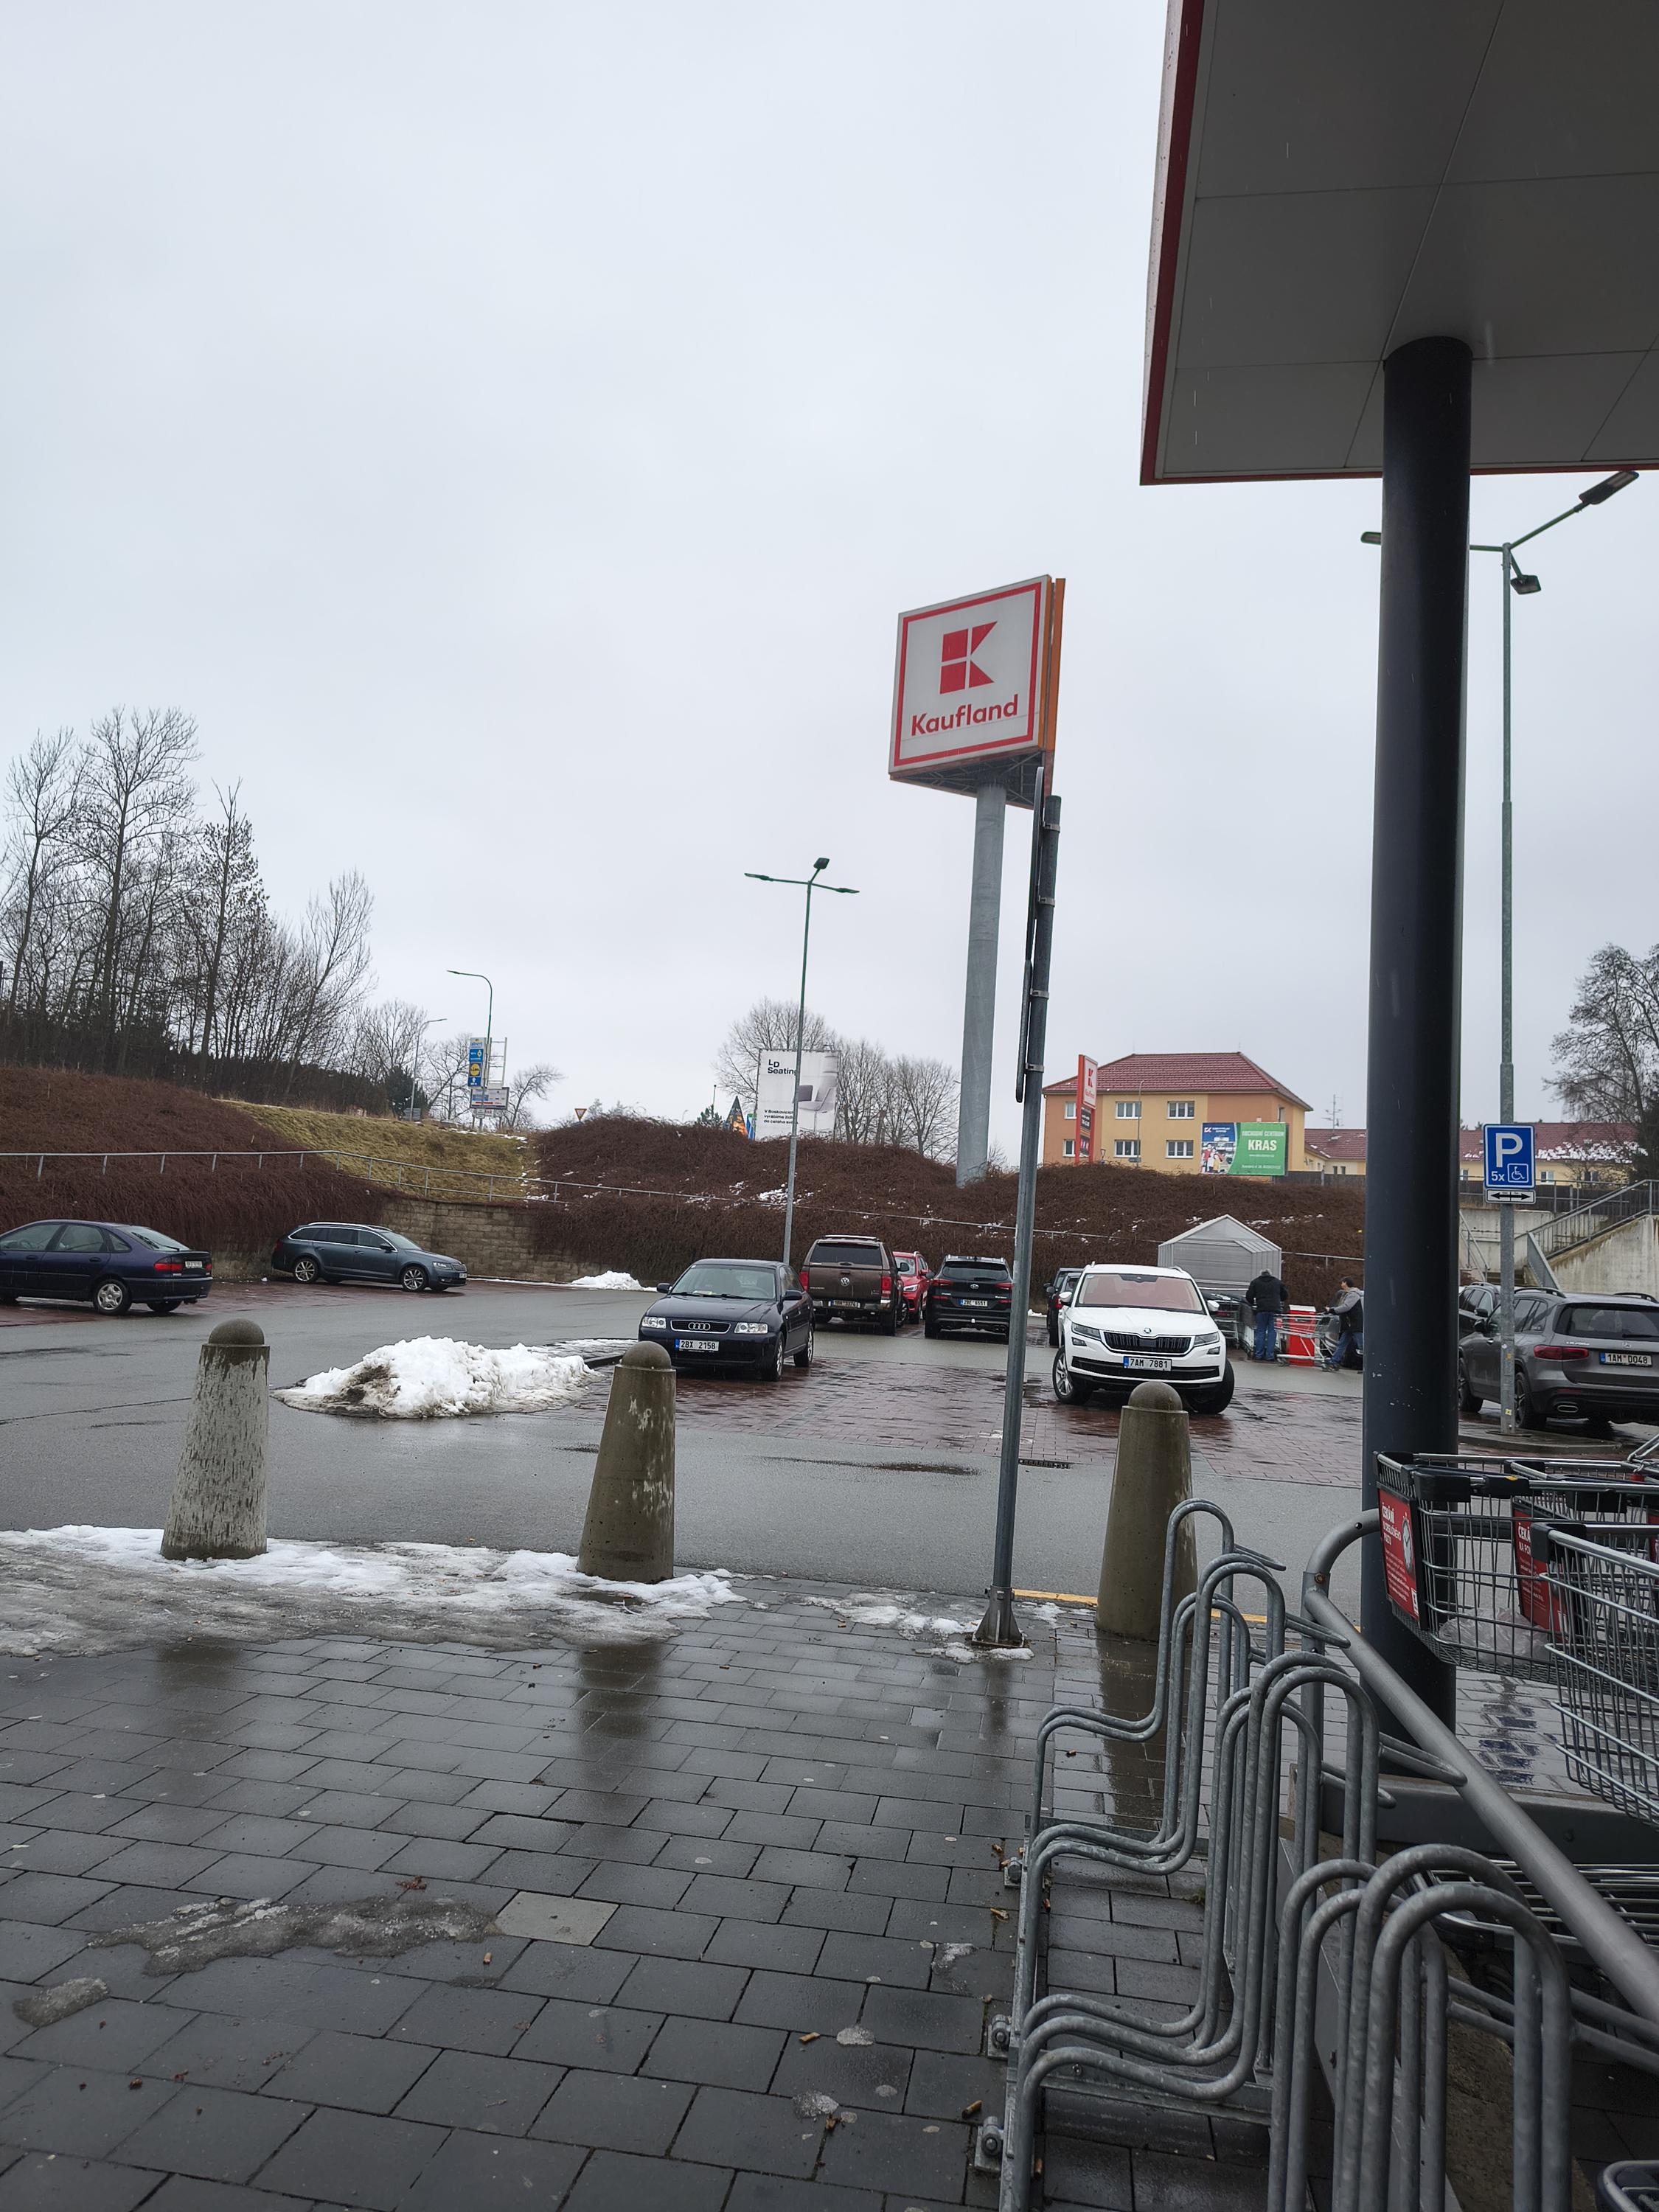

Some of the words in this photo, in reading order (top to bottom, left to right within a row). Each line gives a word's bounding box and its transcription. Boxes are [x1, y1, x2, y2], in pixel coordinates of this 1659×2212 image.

[911, 695, 1018, 736] Kaufland
[1248, 1139, 1277, 1151] KRAS
[1495, 1133, 1523, 1168] P
[1491, 1171, 1505, 1181] 5x
[698, 1341, 715, 1349] 2158
[1130, 1358, 1144, 1366] 7AM
[1150, 1360, 1167, 1368] 7881
[1607, 1354, 1622, 1362] 1AM
[1518, 1522, 1531, 1543] ČEKÁ
